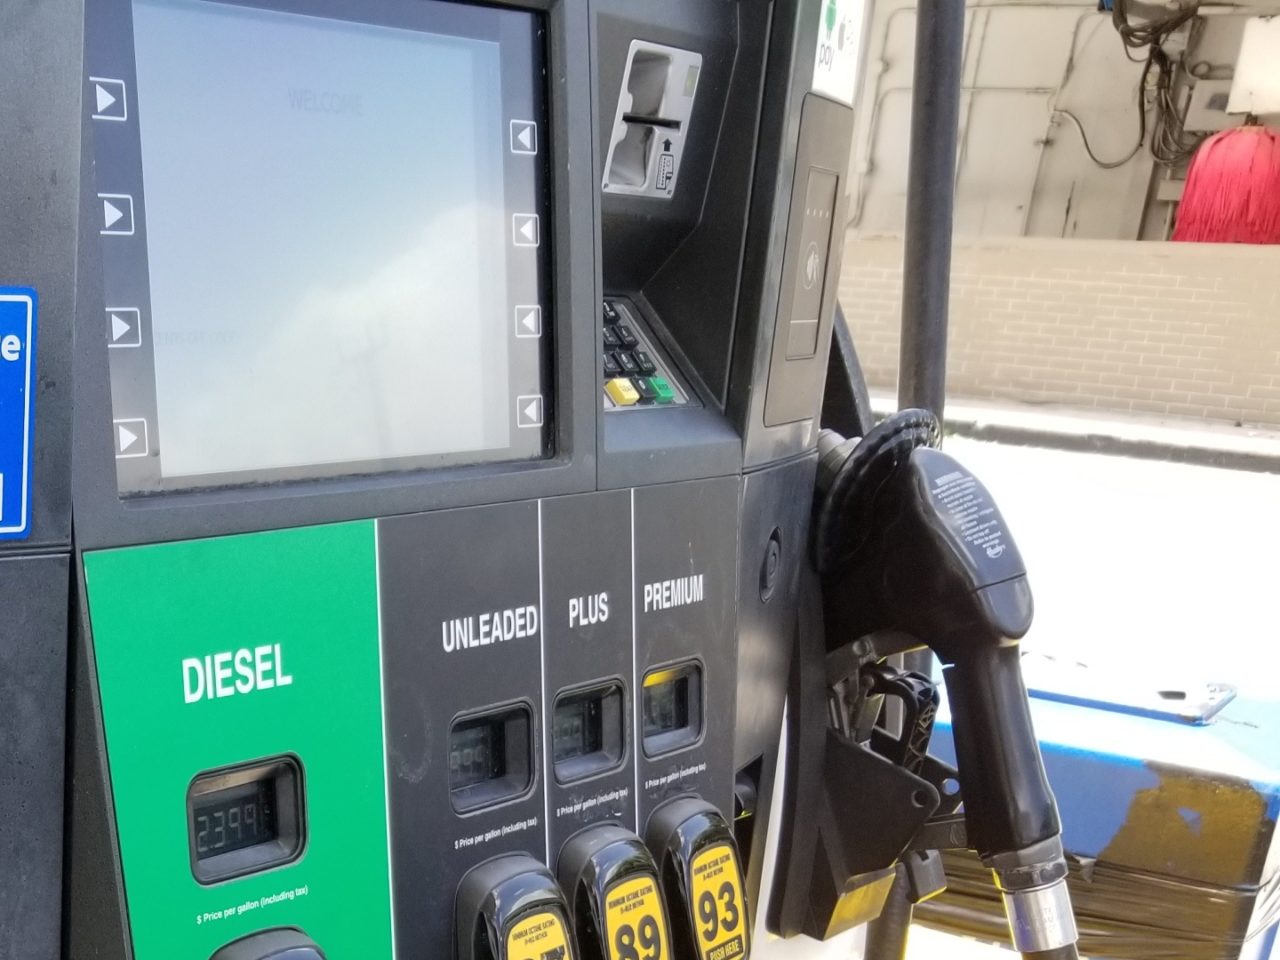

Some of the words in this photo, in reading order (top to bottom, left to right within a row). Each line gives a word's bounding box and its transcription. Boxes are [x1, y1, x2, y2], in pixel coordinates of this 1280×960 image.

[569, 592, 609, 629] PLUS
[643, 574, 704, 613] PREMIUM
[442, 605, 538, 653] UNLEADED
[182, 643, 293, 704] DIESEL
[459, 837, 474, 848] Price
[475, 835, 484, 845] per
[485, 829, 501, 842] gallon
[196, 914, 202, 925] $
[203, 909, 222, 922] Price
[224, 907, 236, 919] per
[237, 900, 260, 915] gallon
[260, 888, 294, 908] (including
[295, 885, 309, 898] tax)
[698, 881, 739, 942] 93
[725, 939, 740, 957] HERE
